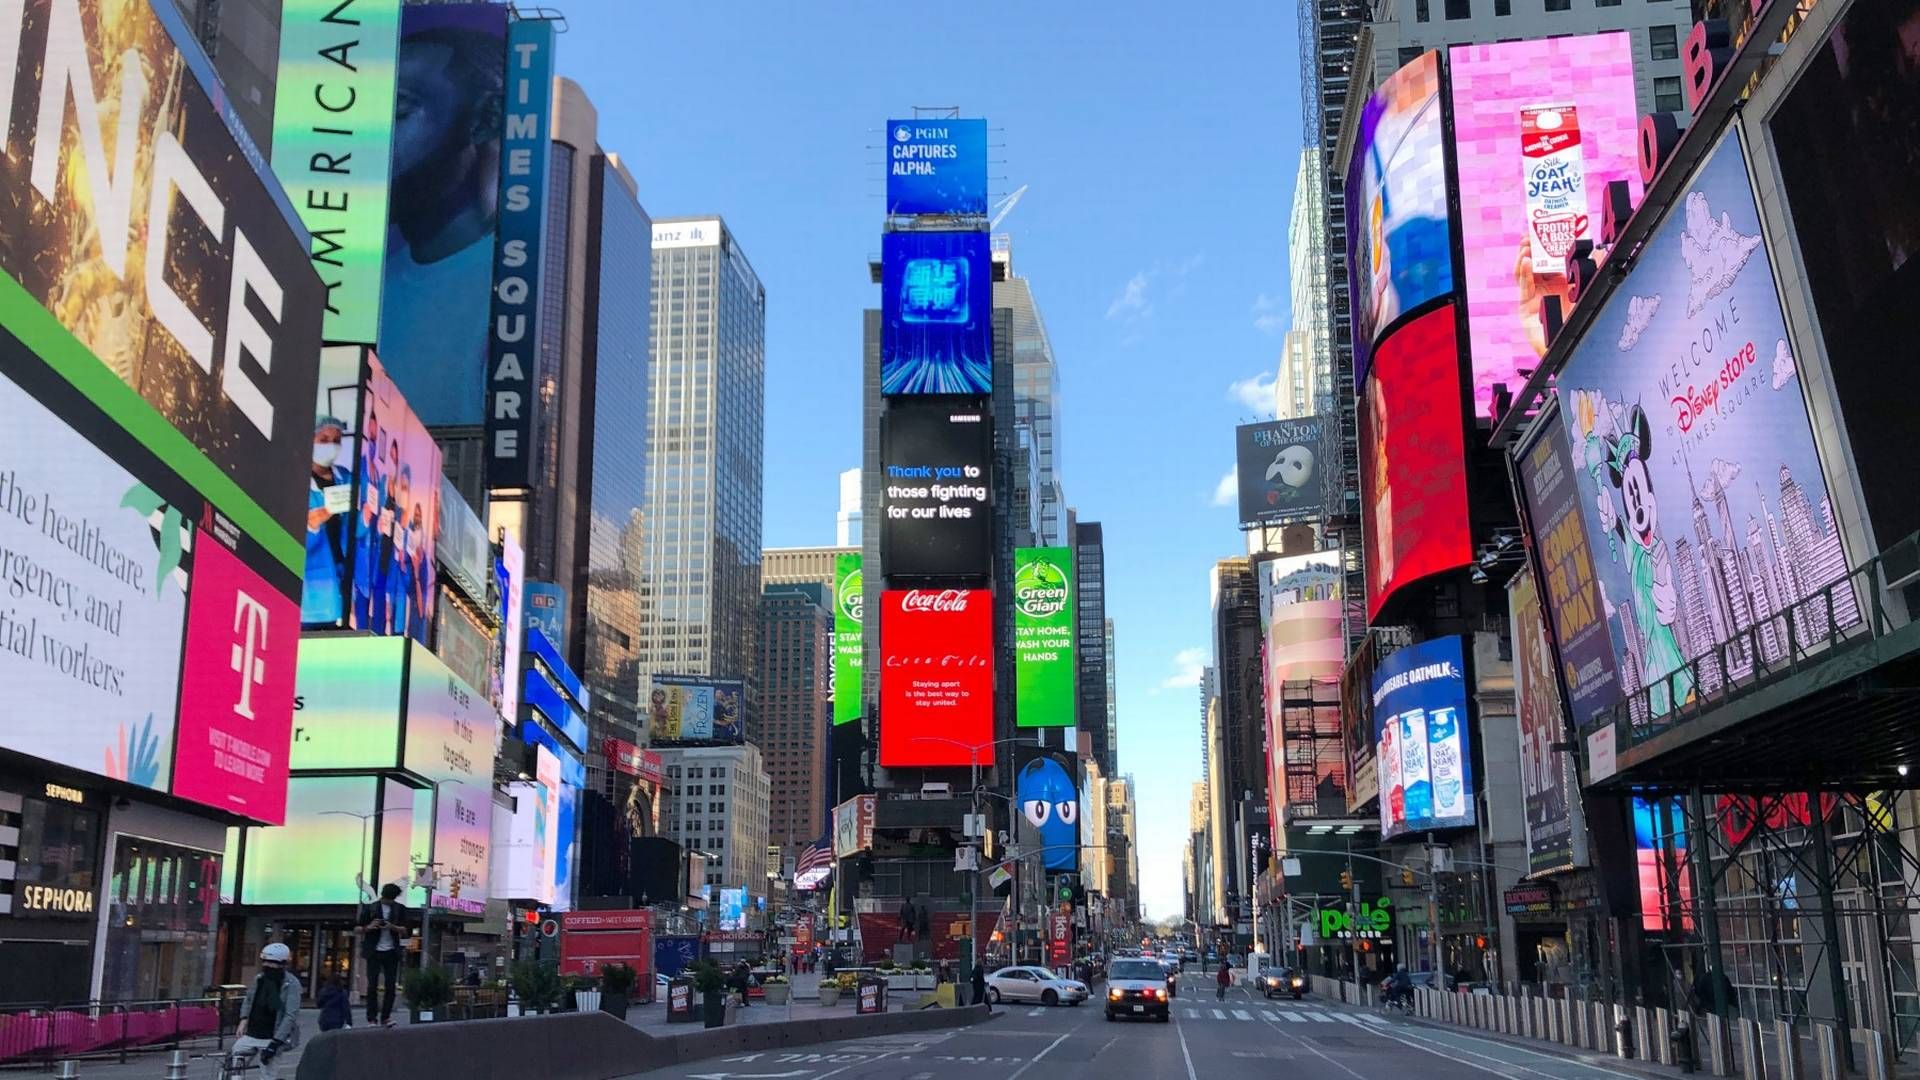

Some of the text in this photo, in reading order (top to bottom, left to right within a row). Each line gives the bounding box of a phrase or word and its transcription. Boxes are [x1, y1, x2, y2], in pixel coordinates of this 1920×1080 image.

[916, 128, 948, 139] PGIM
[893, 144, 957, 159] CAPTURES
[893, 161, 936, 175] ALPHA:
[1536, 162, 1569, 180] OAT
[1528, 177, 1575, 197] YEAH
[0, 0, 284, 441] NCE
[1537, 222, 1569, 235] FROTH
[1551, 232, 1575, 242] BOSS
[494, 43, 538, 458] TIMES SQUARE
[1658, 296, 1740, 399] WELCOME
[1719, 341, 1756, 390] store
[1686, 418, 1716, 453] TIMES
[1722, 369, 1766, 421] SQUARE
[1254, 424, 1321, 442] PHANTOM
[887, 465, 980, 480] Thank you to
[887, 485, 986, 501] those fighting
[887, 505, 971, 518] for our lives
[0, 471, 36, 525] the
[42, 493, 146, 594] healthcare,
[1543, 507, 1585, 573] COME
[0, 547, 122, 637] rgency, and
[902, 590, 970, 612] Coca-Cola
[1018, 587, 1065, 600] Green
[1024, 599, 1066, 613] Giant
[1041, 640, 1070, 648] YOUR
[42, 634, 125, 697] workers:
[1024, 653, 1058, 661] HANDS
[1409, 662, 1450, 684] OATMILK
[912, 681, 960, 690] Staying apart
[915, 699, 957, 708] stay united.
[944, 691, 959, 699] way
[692, 689, 708, 735] FROZEN
[45, 783, 83, 804] SEPHORA
[23, 885, 93, 912] SEPHORA
